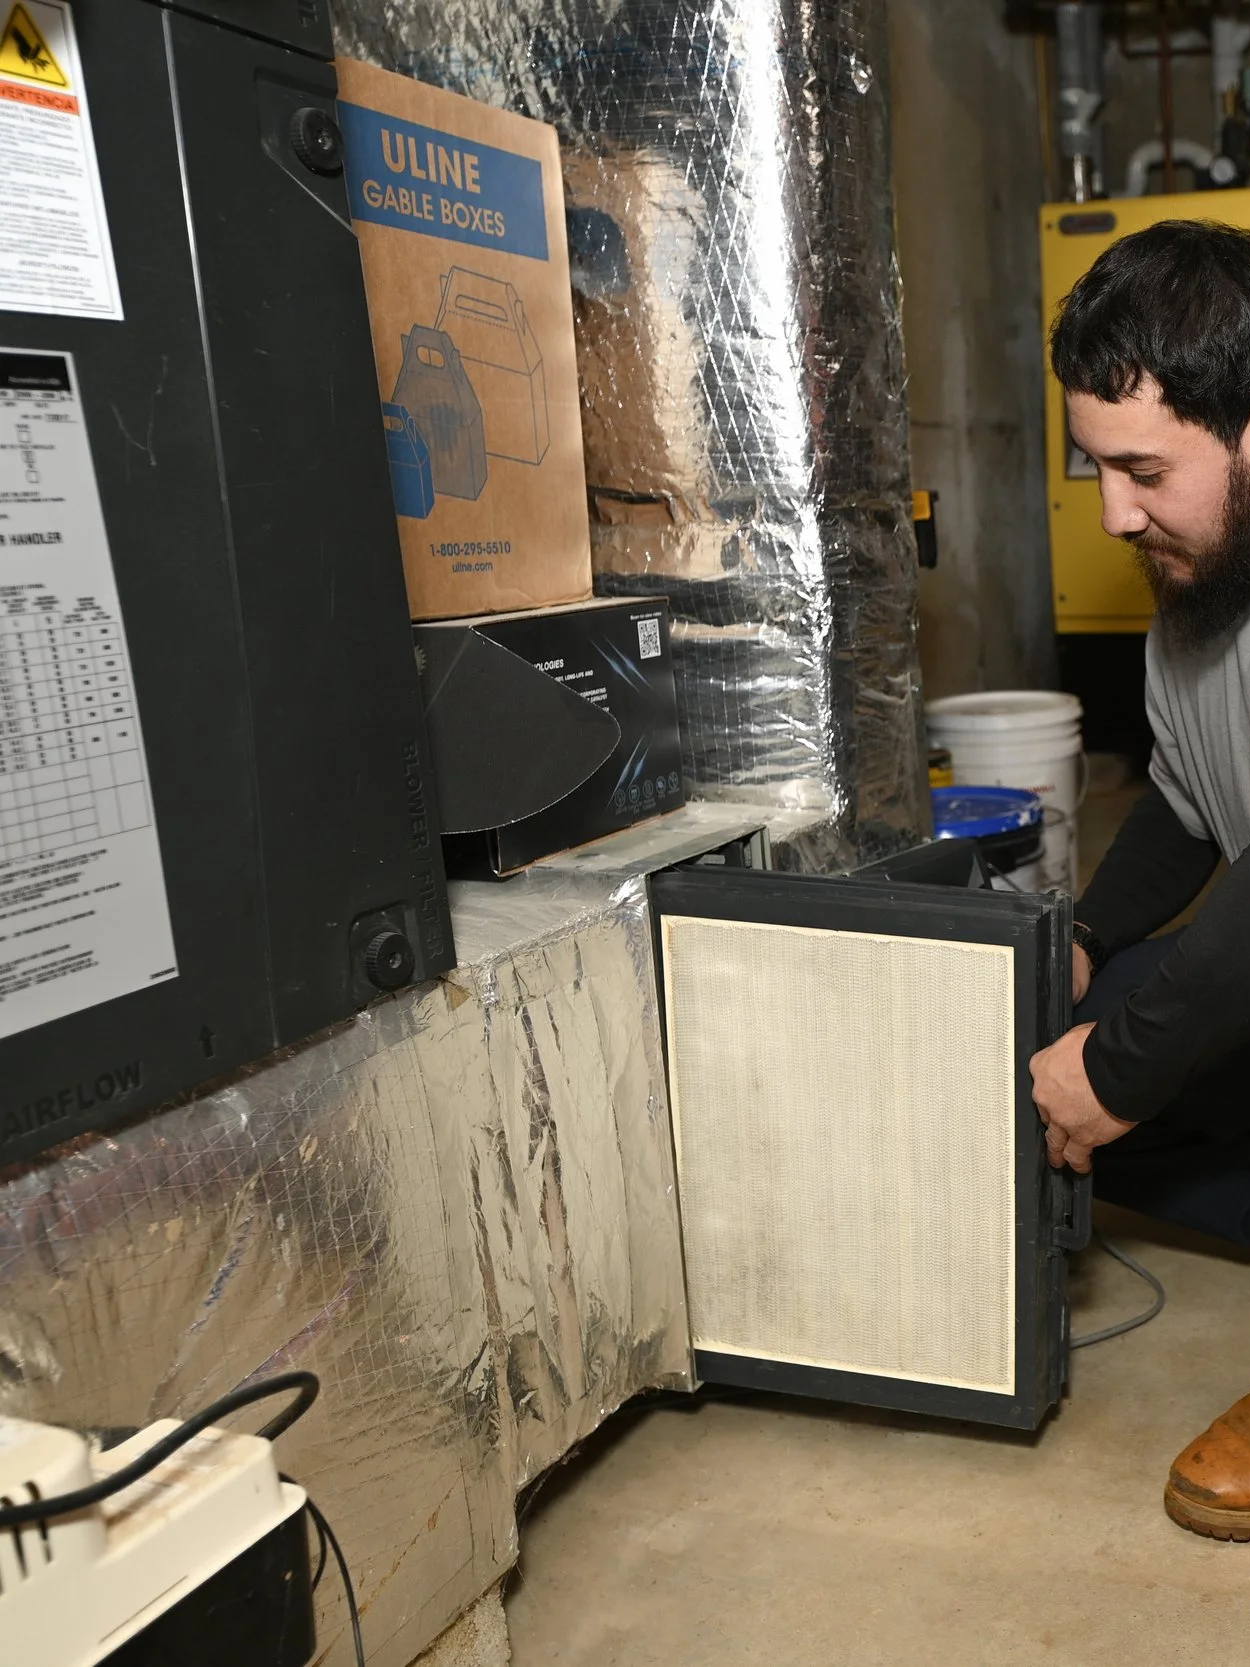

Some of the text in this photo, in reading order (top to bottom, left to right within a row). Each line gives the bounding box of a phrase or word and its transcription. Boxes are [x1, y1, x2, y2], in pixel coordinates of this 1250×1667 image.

[381, 128, 481, 194] ULINE
[362, 179, 506, 238] GABLE BOXES
[430, 541, 511, 557] 1-800-295-5510
[452, 562, 493, 573] uline.com
[533, 658, 564, 672] OLOGIES
[580, 687, 607, 698] CORPORATING
[402, 739, 430, 852] BLOWER
[416, 868, 445, 960] FILTER
[2, 1060, 143, 1145] AIRFLOW
